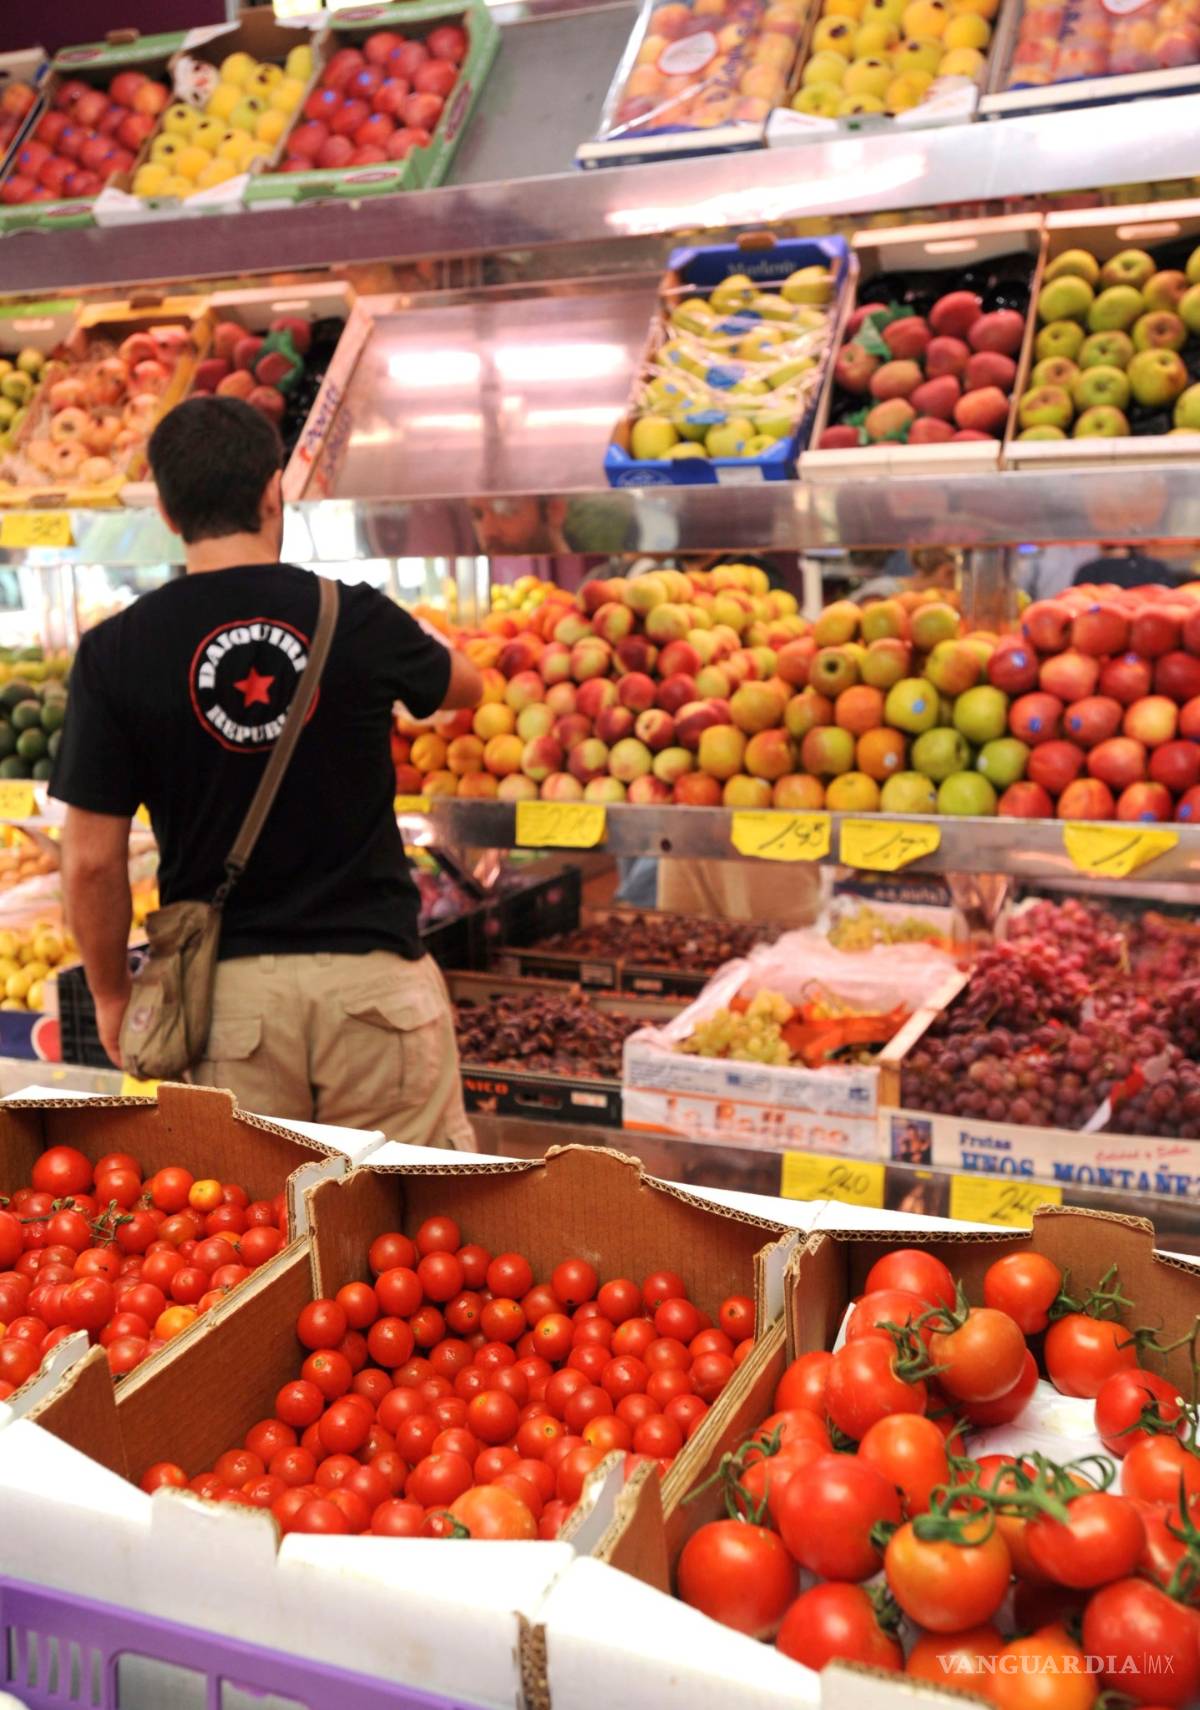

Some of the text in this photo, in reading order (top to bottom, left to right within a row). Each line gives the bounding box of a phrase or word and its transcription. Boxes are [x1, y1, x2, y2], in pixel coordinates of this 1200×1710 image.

[198, 623, 308, 689] DAIQUIRI
[205, 703, 291, 743] REPUB
[960, 1132, 1011, 1150] Frutas
